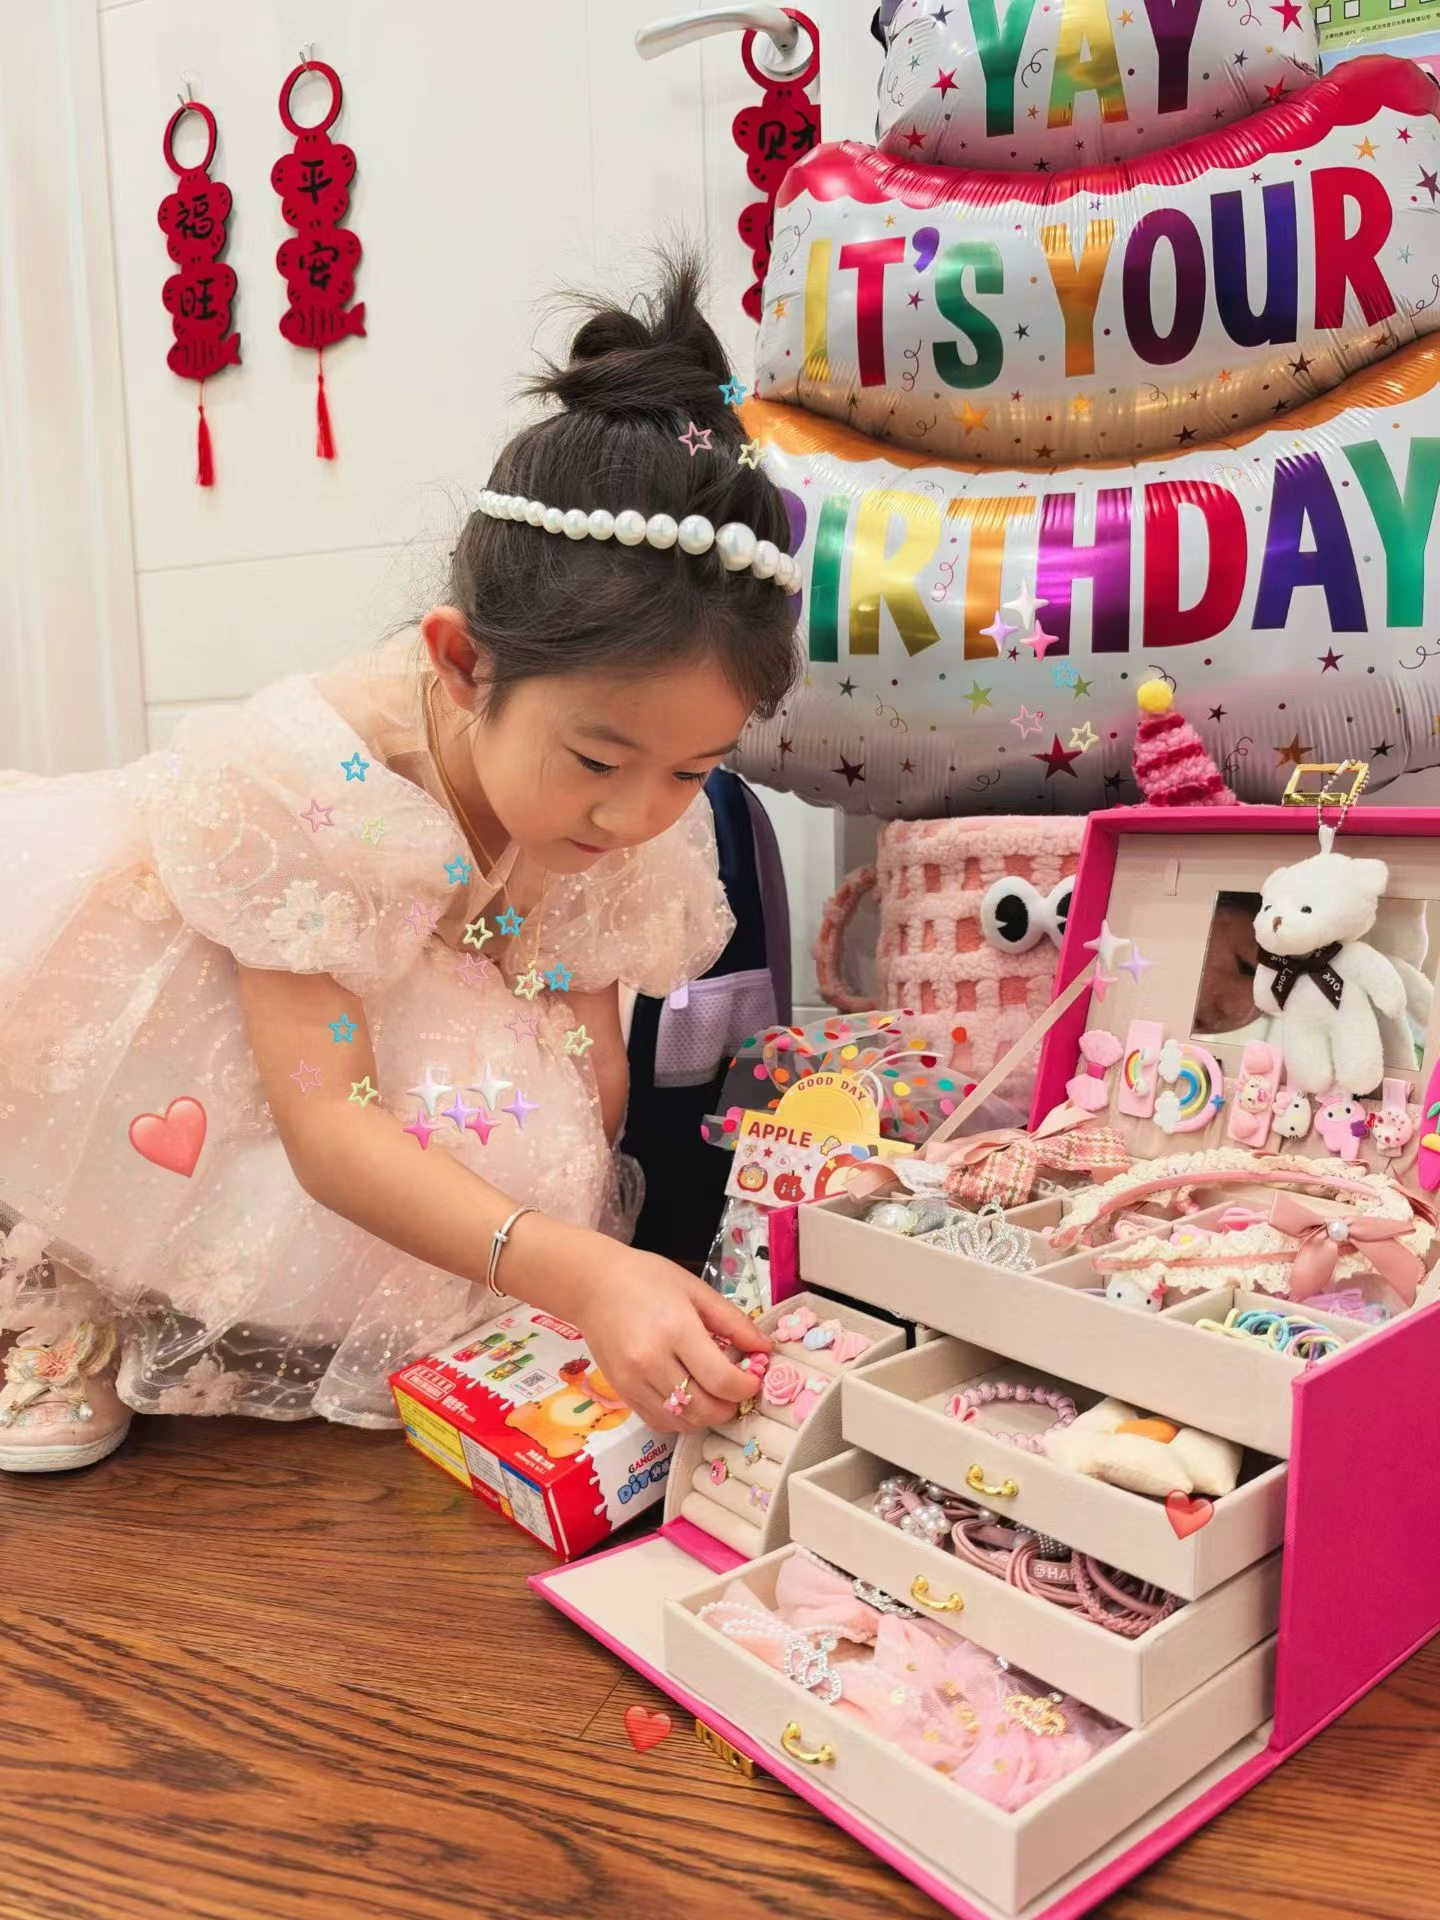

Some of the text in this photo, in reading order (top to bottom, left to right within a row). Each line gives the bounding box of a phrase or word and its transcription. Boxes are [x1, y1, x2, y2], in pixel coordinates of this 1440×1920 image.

[966, 0, 1202, 137] YAY
[175, 194, 217, 320] 福旺
[298, 159, 340, 291] 平安
[799, 165, 1397, 389] IT'S YOUR
[777, 436, 1440, 663] IRTHDAY
[748, 1121, 813, 1148] APPLE
[797, 1076, 867, 1101] GOOD DAY
[628, 1443, 667, 1473] GANGRUI
